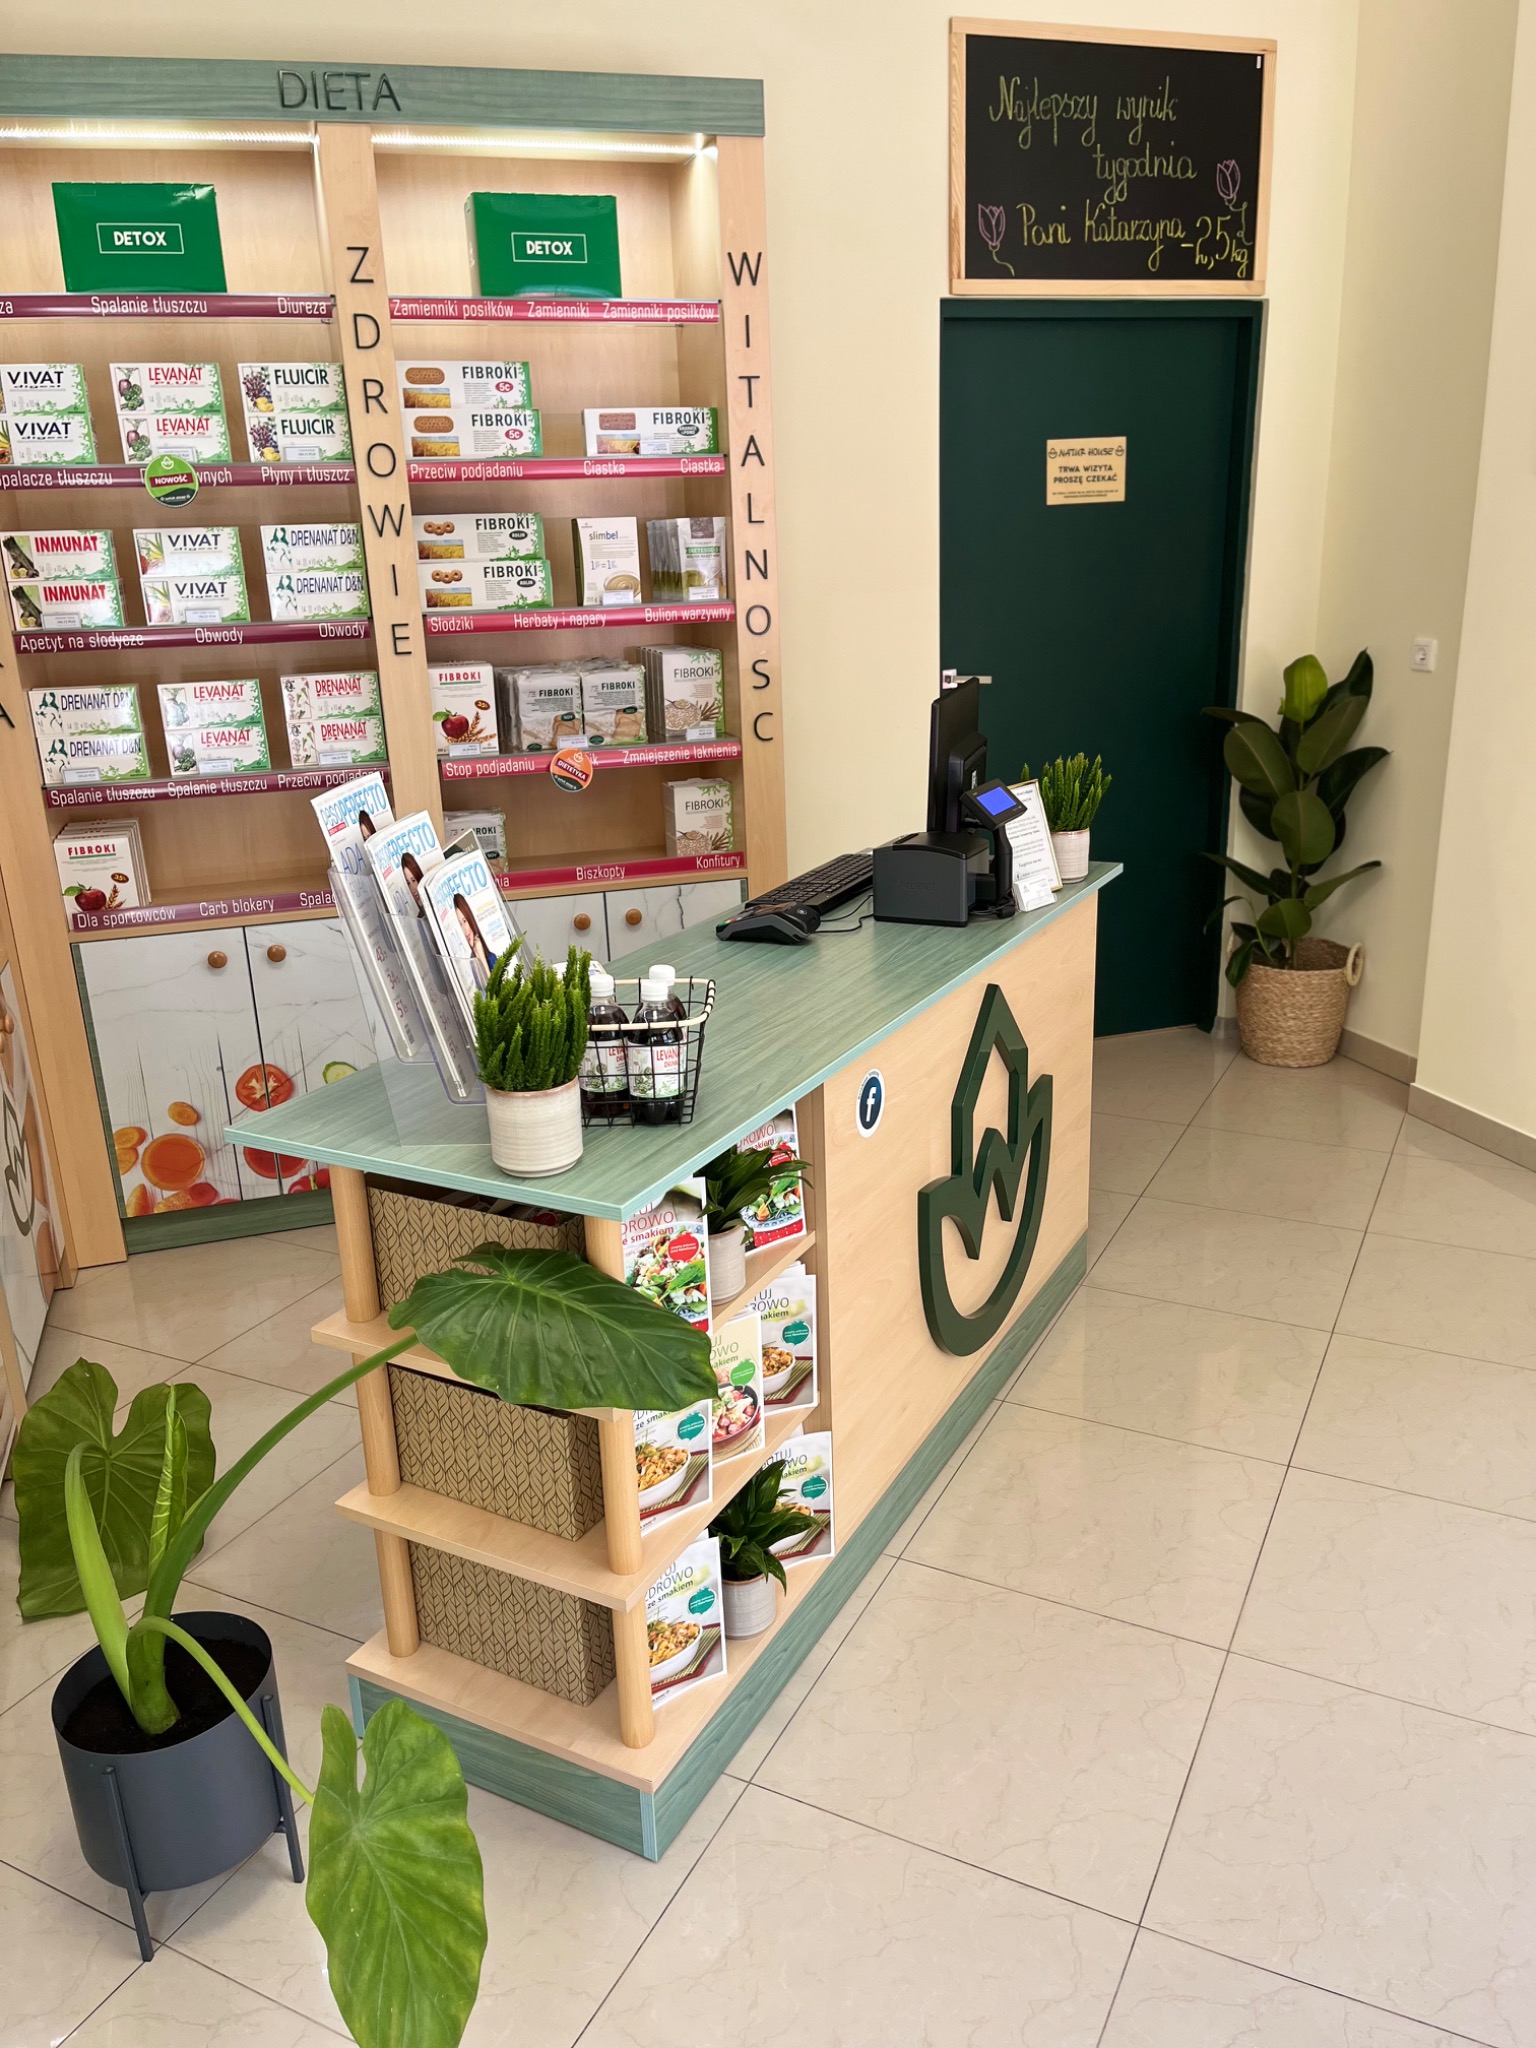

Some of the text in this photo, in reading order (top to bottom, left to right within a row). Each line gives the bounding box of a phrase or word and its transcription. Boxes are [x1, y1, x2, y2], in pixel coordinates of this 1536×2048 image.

[277, 69, 401, 112] DIETA
[989, 75, 1177, 149] Najlepszy wynik
[1092, 141, 1197, 205] tygodnia
[113, 231, 167, 247] DETOX
[1016, 203, 1071, 246] Pani
[1085, 199, 1186, 272] Katarzyna
[526, 240, 573, 256] DETOX
[91, 297, 148, 316] Spalanie
[154, 297, 208, 314] tłuszczu
[277, 297, 327, 315] Diureza
[393, 299, 715, 322] Zamienniki posiłków Zamienniki Zamienniki posiłków
[7, 371, 64, 385] VIVAT
[148, 367, 203, 381] LEVANAT
[274, 369, 329, 385] FLUICIR
[462, 366, 518, 379] FIBROKI
[156, 418, 210, 432] LEVANAT
[281, 419, 336, 435] FLUICIR
[471, 413, 528, 427] FIBROKI
[653, 412, 705, 425] FIBROKI
[15, 422, 72, 436] VIVAT
[346, 247, 413, 656] ZDROWIE
[410, 458, 721, 481] Przeciw podjadaniu Ciastka Ciastka
[1083, 464, 1113, 472] WIZYTA
[0, 469, 53, 490] palacze
[57, 469, 113, 486] tłuszczu
[261, 466, 294, 486] Płyny
[307, 466, 350, 482] tłuszcz
[154, 473, 188, 485] NOWOŚĆ
[1053, 472, 1118, 485] PROSZĘ CZEKAĆ
[475, 517, 530, 531] FIBROKI
[34, 536, 98, 553] INMUNAT
[168, 533, 221, 547] VIVAT
[291, 528, 359, 547] DRENANAT D&N
[589, 531, 619, 541] slimbel
[483, 565, 538, 579] FIBROKI
[43, 584, 106, 603] INMUNAT
[175, 581, 228, 596] VIVAT
[296, 576, 364, 594] DRENANAT D&N
[430, 615, 475, 633] Słodziki
[513, 613, 559, 630] Herbaty
[569, 613, 607, 628] napary
[644, 608, 678, 622] Bulion
[681, 606, 731, 622] warzywny
[20, 623, 366, 654] Apetyt na słodycze Obwody Obwody
[439, 671, 481, 683] FIBROKI
[673, 667, 714, 679] FIBROKI
[193, 683, 245, 700] LEVANAT
[315, 677, 362, 694] DRENANAT
[539, 688, 574, 698] FIBROKI
[601, 681, 636, 691] FIBROKI
[61, 692, 111, 712] DRENANAT
[201, 729, 251, 745] LEVANAT
[321, 721, 367, 739] DRENANAT
[69, 739, 119, 758] DRENANAT
[445, 762, 472, 778] Stop
[476, 759, 535, 777] podjadaniu
[622, 749, 691, 765] Zmniejszenie
[694, 745, 738, 760] łaknienia
[557, 760, 586, 780] DIETETYKA
[51, 788, 103, 807] Spalanie
[106, 785, 156, 802] tłuszczu
[167, 780, 218, 798] Spalanie
[221, 778, 268, 794] tłuszczu
[277, 774, 324, 789] Przeciw
[685, 798, 724, 812] FIBROKI
[67, 843, 117, 857] FIBROKI
[575, 866, 626, 881] Biszkopty
[696, 855, 741, 870] Konfitury
[77, 912, 99, 929] Dla
[102, 907, 176, 928] sportowców
[199, 902, 229, 917] Carb
[233, 897, 275, 913] blokery
[630, 1226, 675, 1244] smakiem
[657, 1579, 695, 1603] smakiem
